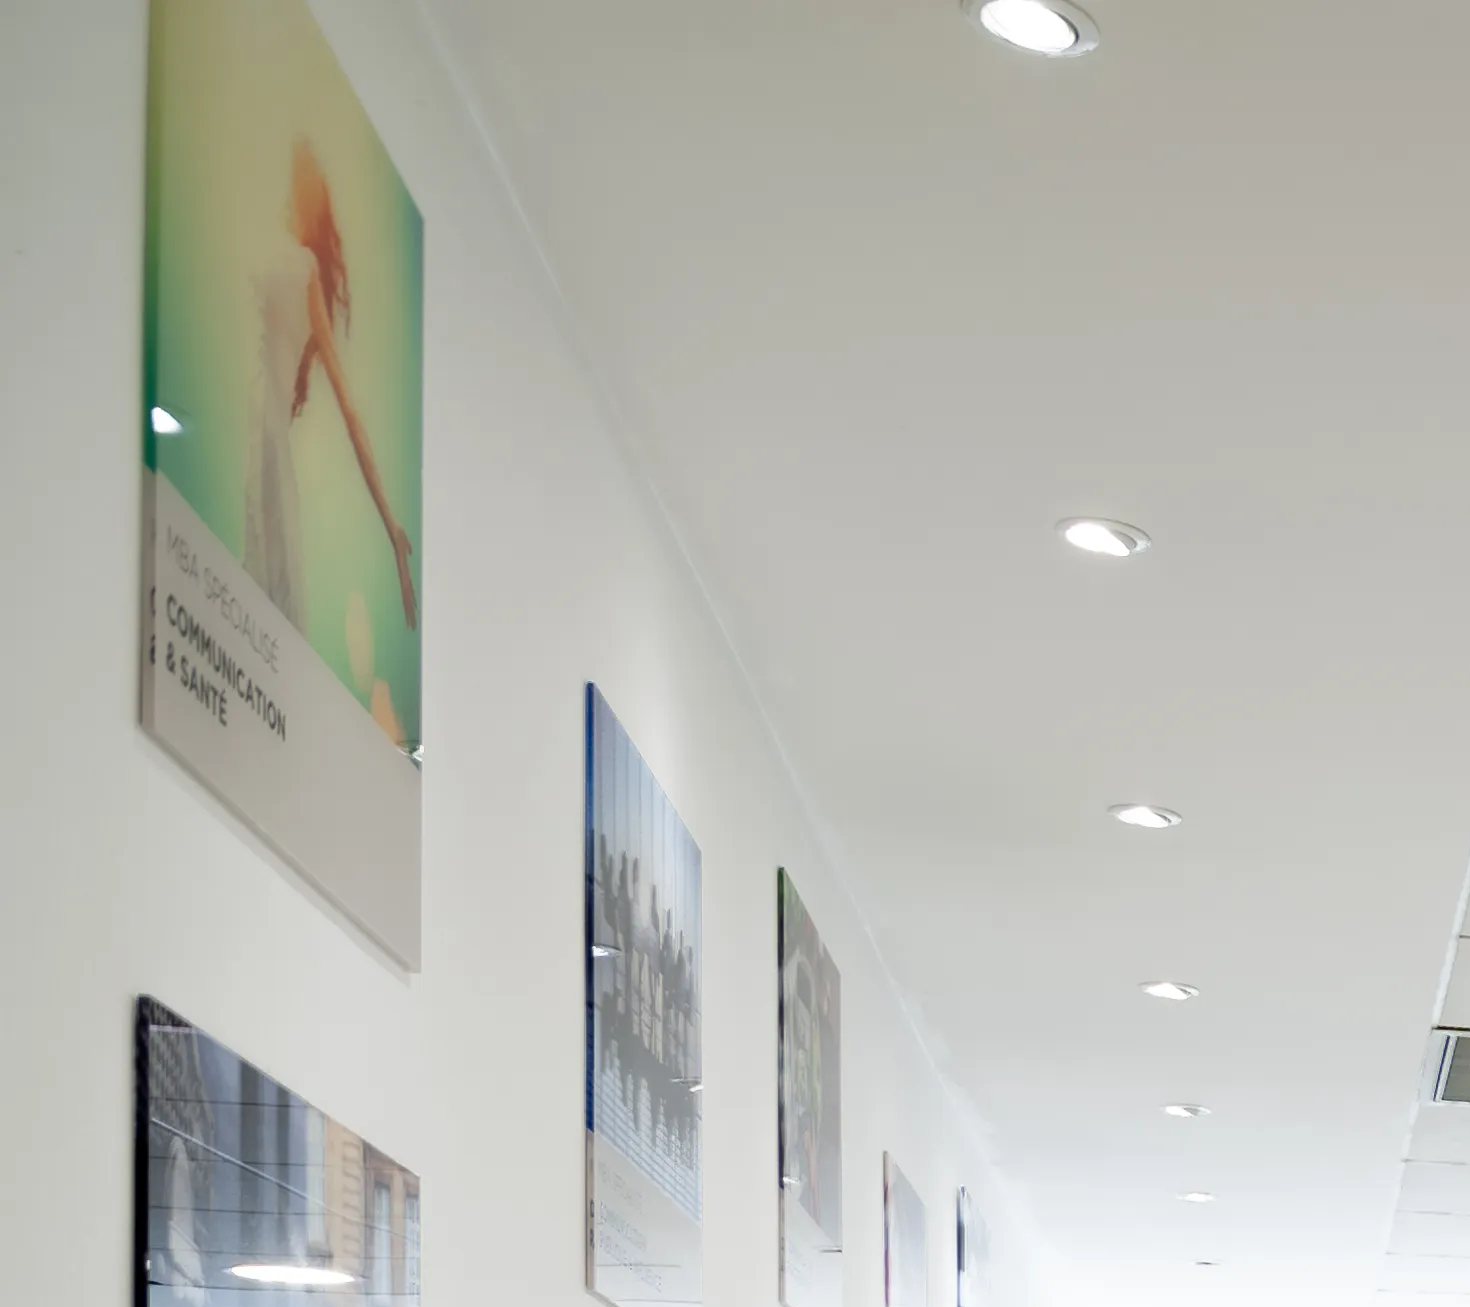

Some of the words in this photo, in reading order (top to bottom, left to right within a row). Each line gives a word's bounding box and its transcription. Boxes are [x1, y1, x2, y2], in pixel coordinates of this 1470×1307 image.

[166, 525, 199, 582] MBA
[203, 565, 280, 675] SPÉCIALISÉ
[166, 593, 286, 742] COMMUNICATION
[166, 640, 176, 675] &
[180, 653, 228, 727] SANTÉ
